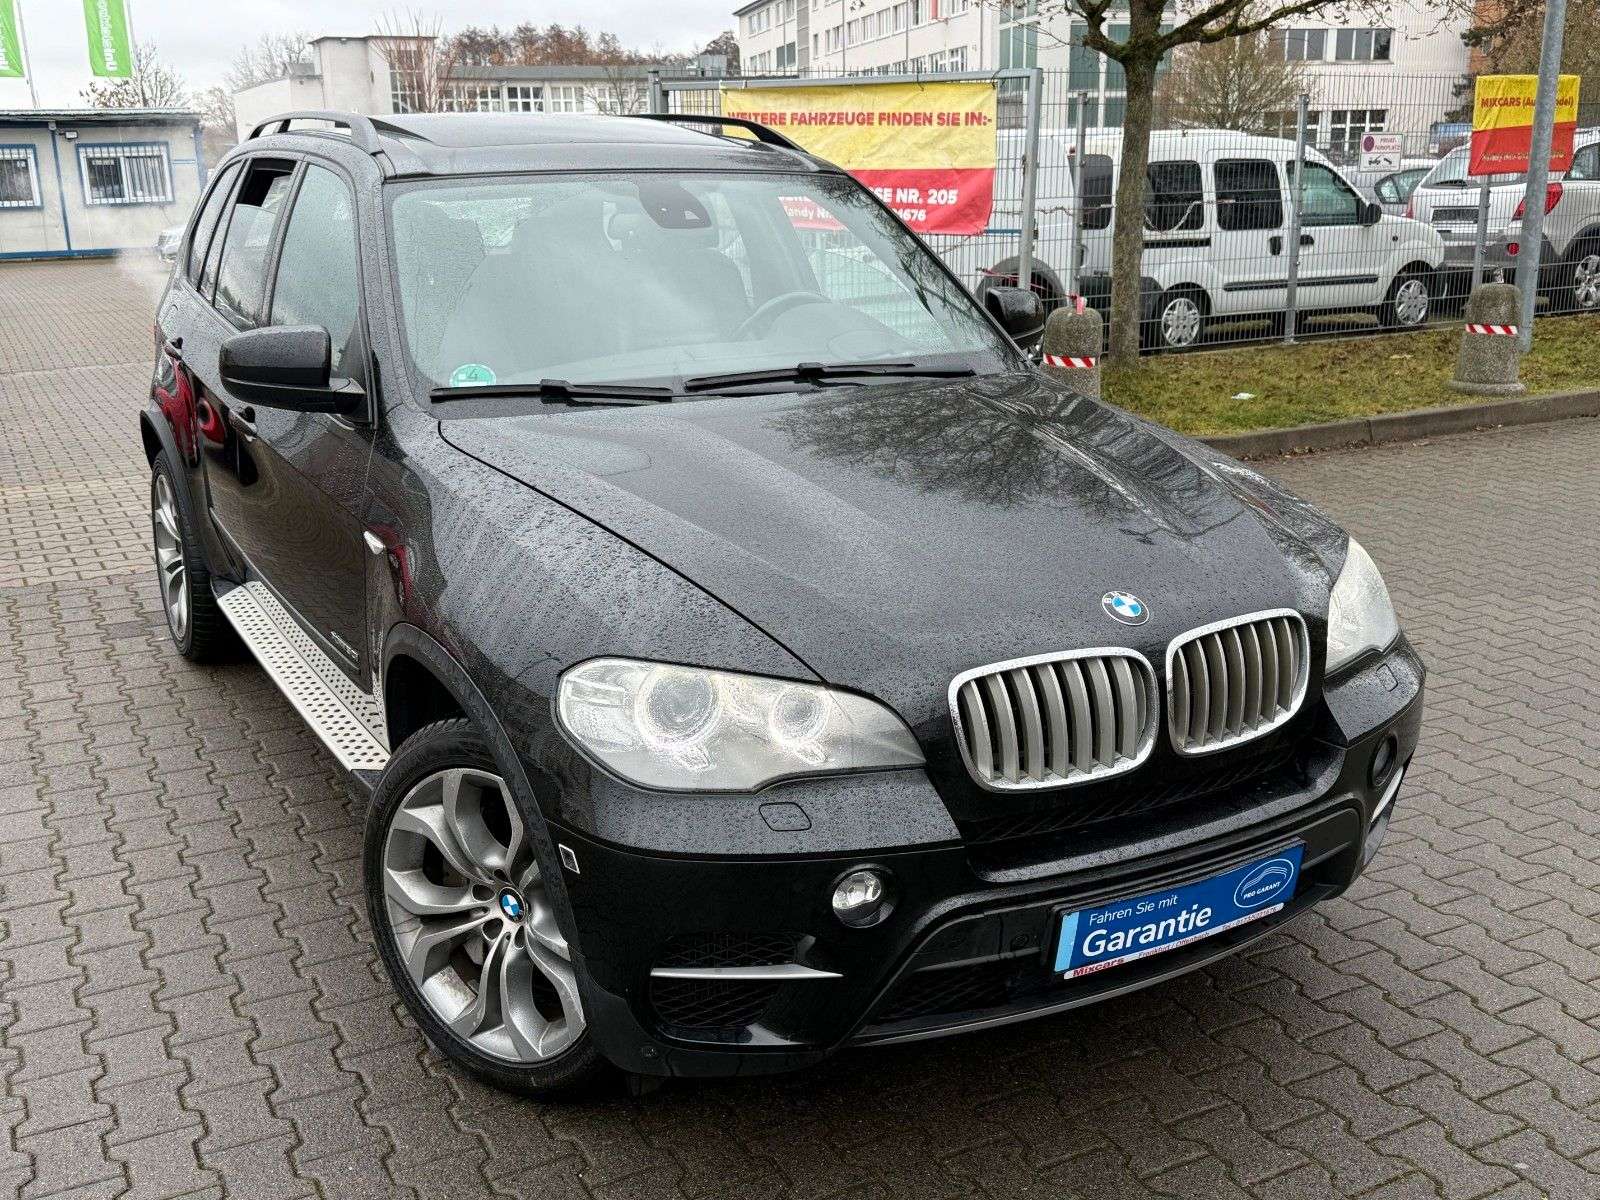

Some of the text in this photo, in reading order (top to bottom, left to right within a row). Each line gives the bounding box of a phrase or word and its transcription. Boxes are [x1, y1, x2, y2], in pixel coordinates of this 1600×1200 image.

[1481, 97, 1521, 108] MIXCARS
[790, 111, 875, 126] FAHRZEUGE
[878, 111, 933, 126] FINDEN
[936, 111, 961, 126] SIE
[895, 187, 923, 204] NR.
[926, 188, 959, 205] 205
[1256, 881, 1281, 895] GARANT
[1089, 894, 1178, 926] Fahren Sie mit
[1082, 904, 1212, 957] Garantie
[1073, 958, 1124, 977] Mixcars
